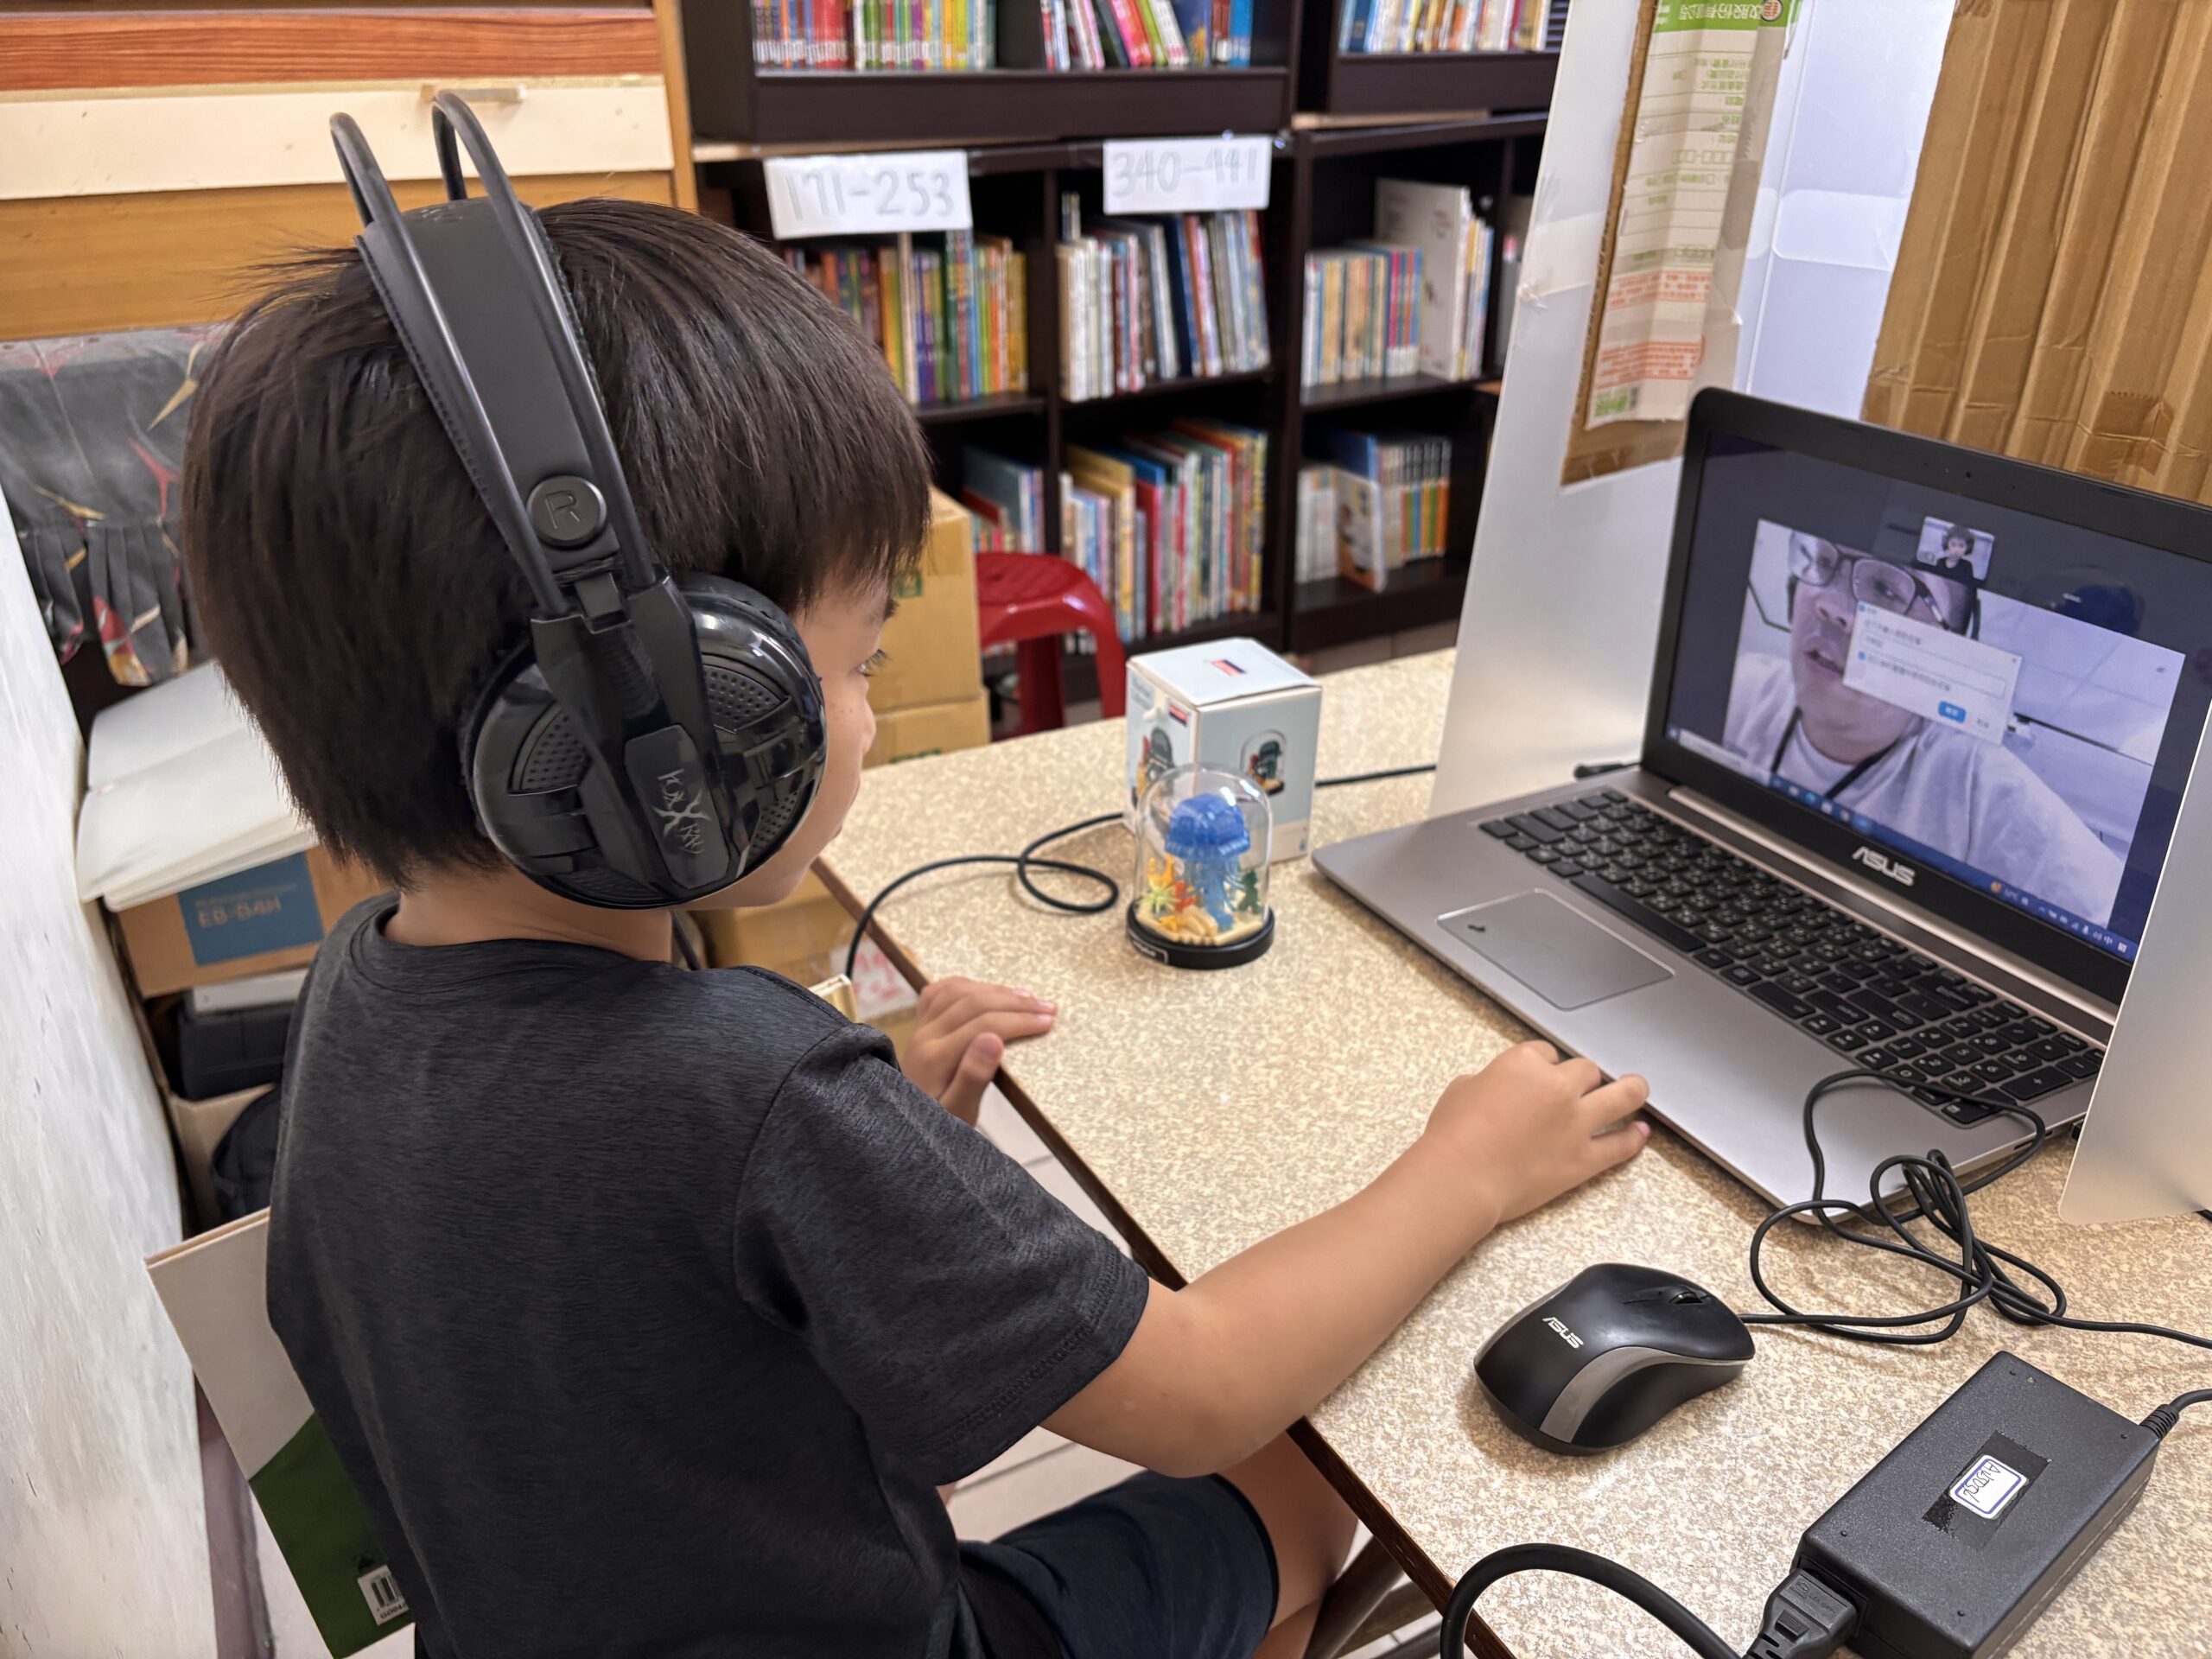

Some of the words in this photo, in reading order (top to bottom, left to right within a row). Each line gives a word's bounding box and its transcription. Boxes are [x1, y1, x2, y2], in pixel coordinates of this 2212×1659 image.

[1111, 147, 1258, 197] 340-441
[783, 168, 954, 221] 171-253
[544, 490, 581, 531] R
[1852, 846, 1916, 887] ASUS
[1541, 1316, 1584, 1349] ASUS
